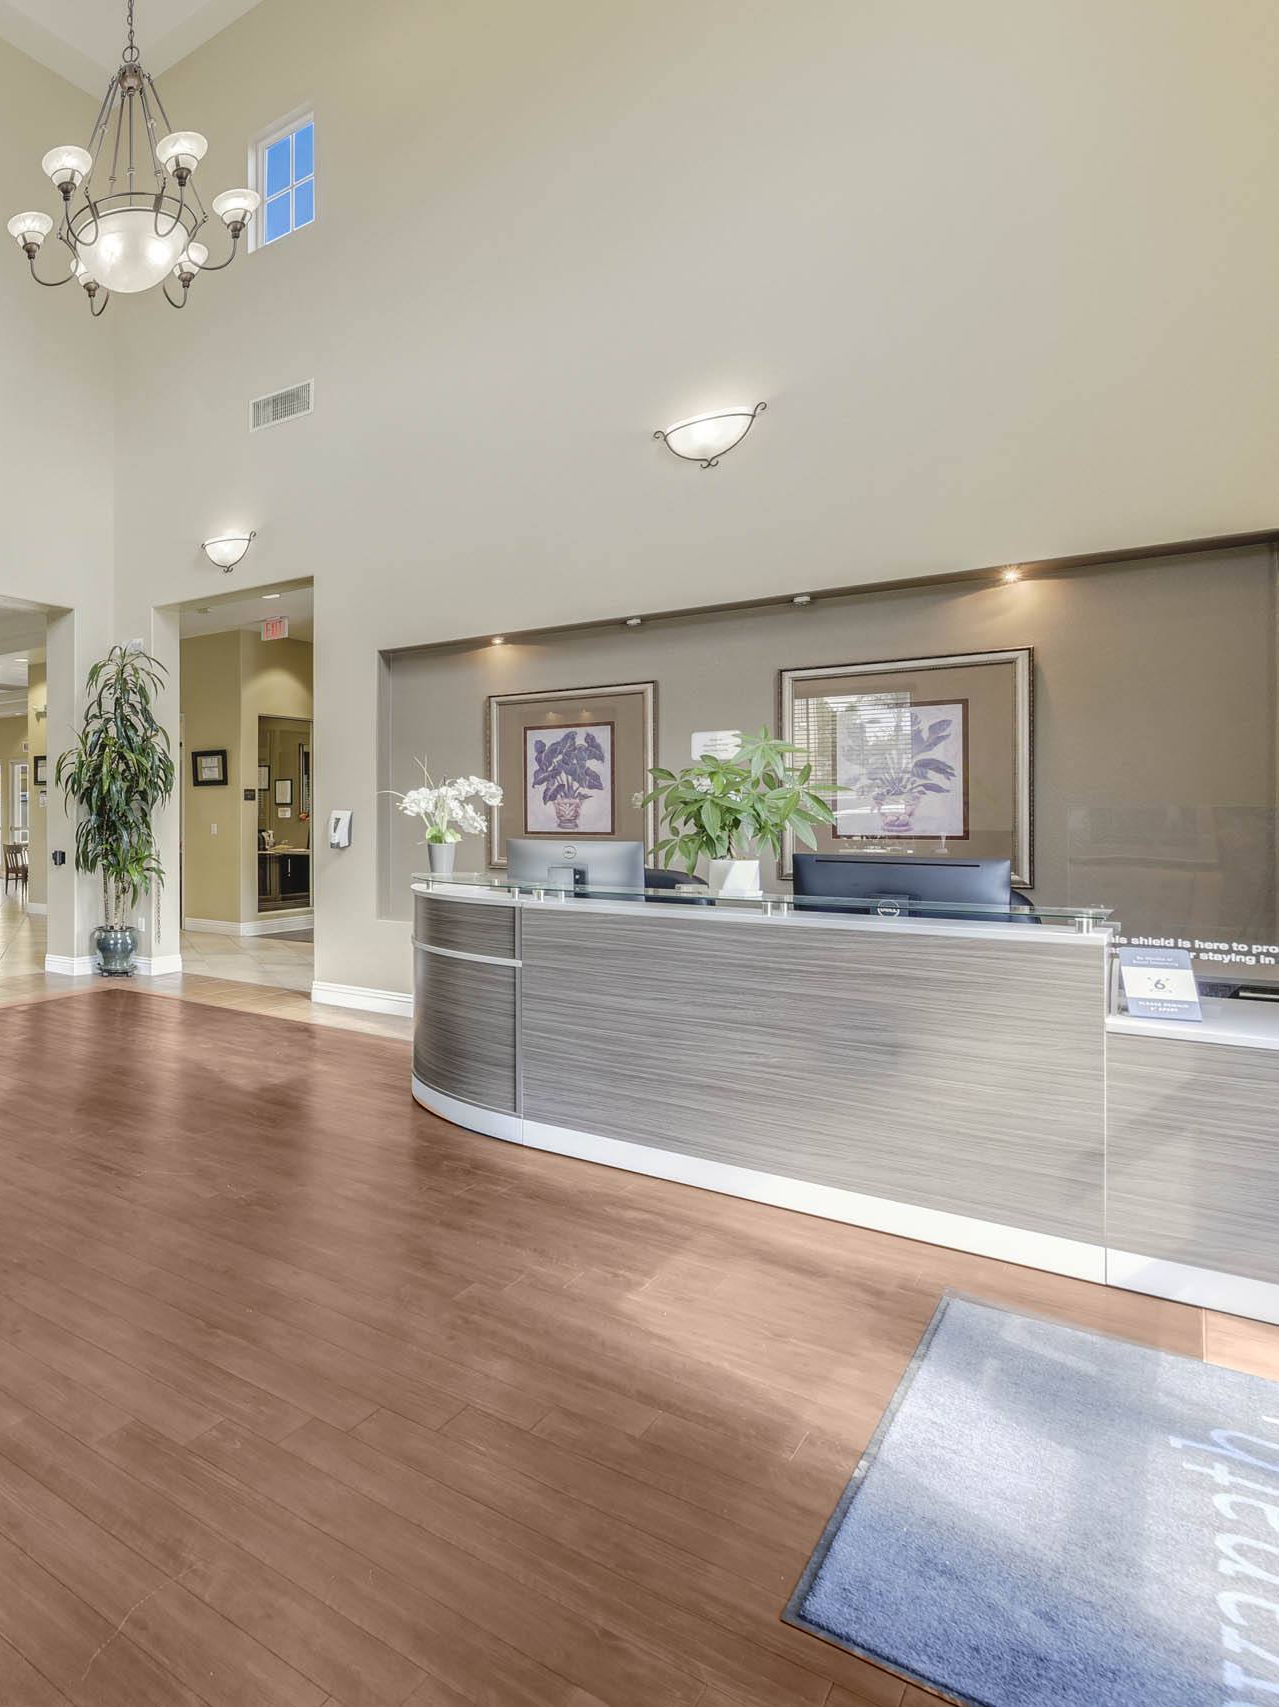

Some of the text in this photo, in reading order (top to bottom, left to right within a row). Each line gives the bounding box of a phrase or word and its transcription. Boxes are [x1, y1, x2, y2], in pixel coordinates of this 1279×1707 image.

[264, 622, 287, 639] EXIT
[1130, 936, 1175, 947] shield
[1178, 938, 1191, 948] is
[1194, 940, 1230, 951] here
[1231, 942, 1249, 952] to
[1252, 944, 1279, 954] pro
[1199, 952, 1256, 965] staying
[1260, 954, 1275, 964] in
[1154, 979, 1166, 990] 6
